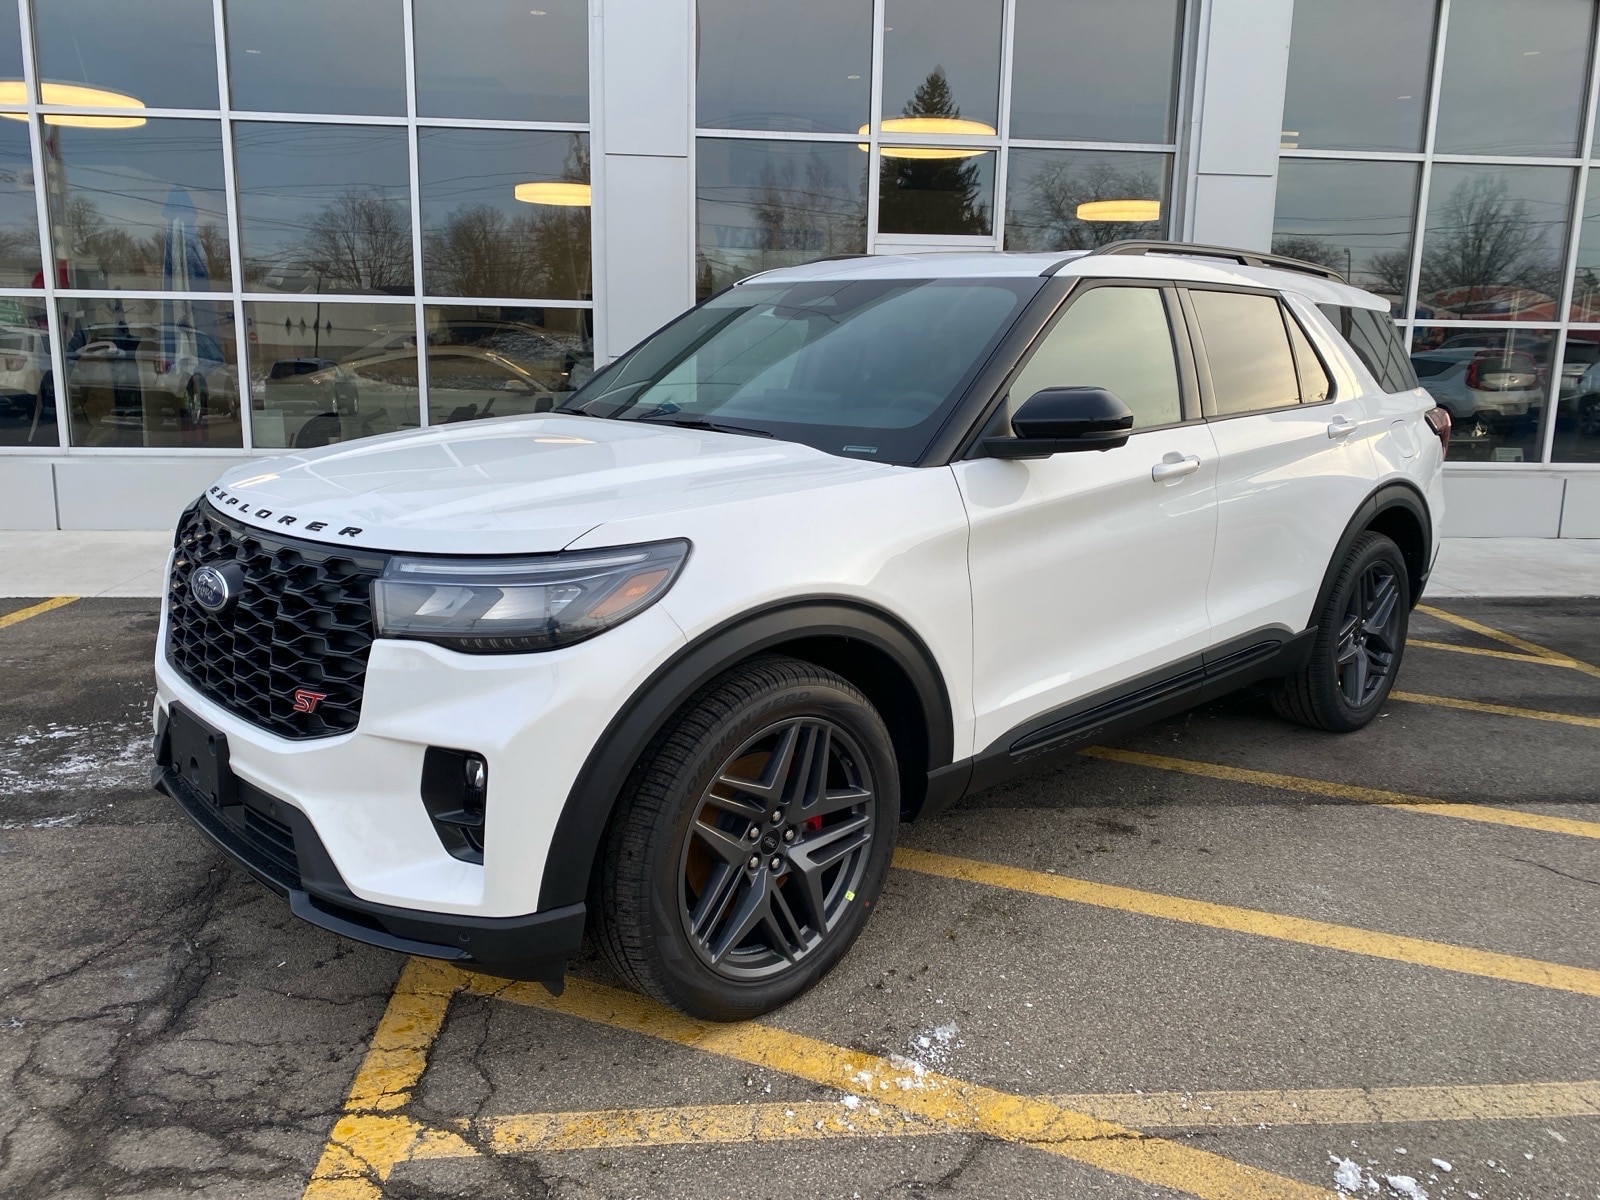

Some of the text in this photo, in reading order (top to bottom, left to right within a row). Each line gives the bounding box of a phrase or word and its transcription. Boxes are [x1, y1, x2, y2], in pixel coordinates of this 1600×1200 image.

[209, 485, 363, 538] EXPLORER
[293, 689, 327, 713] ST
[672, 690, 811, 822] SCORPION ZERO
